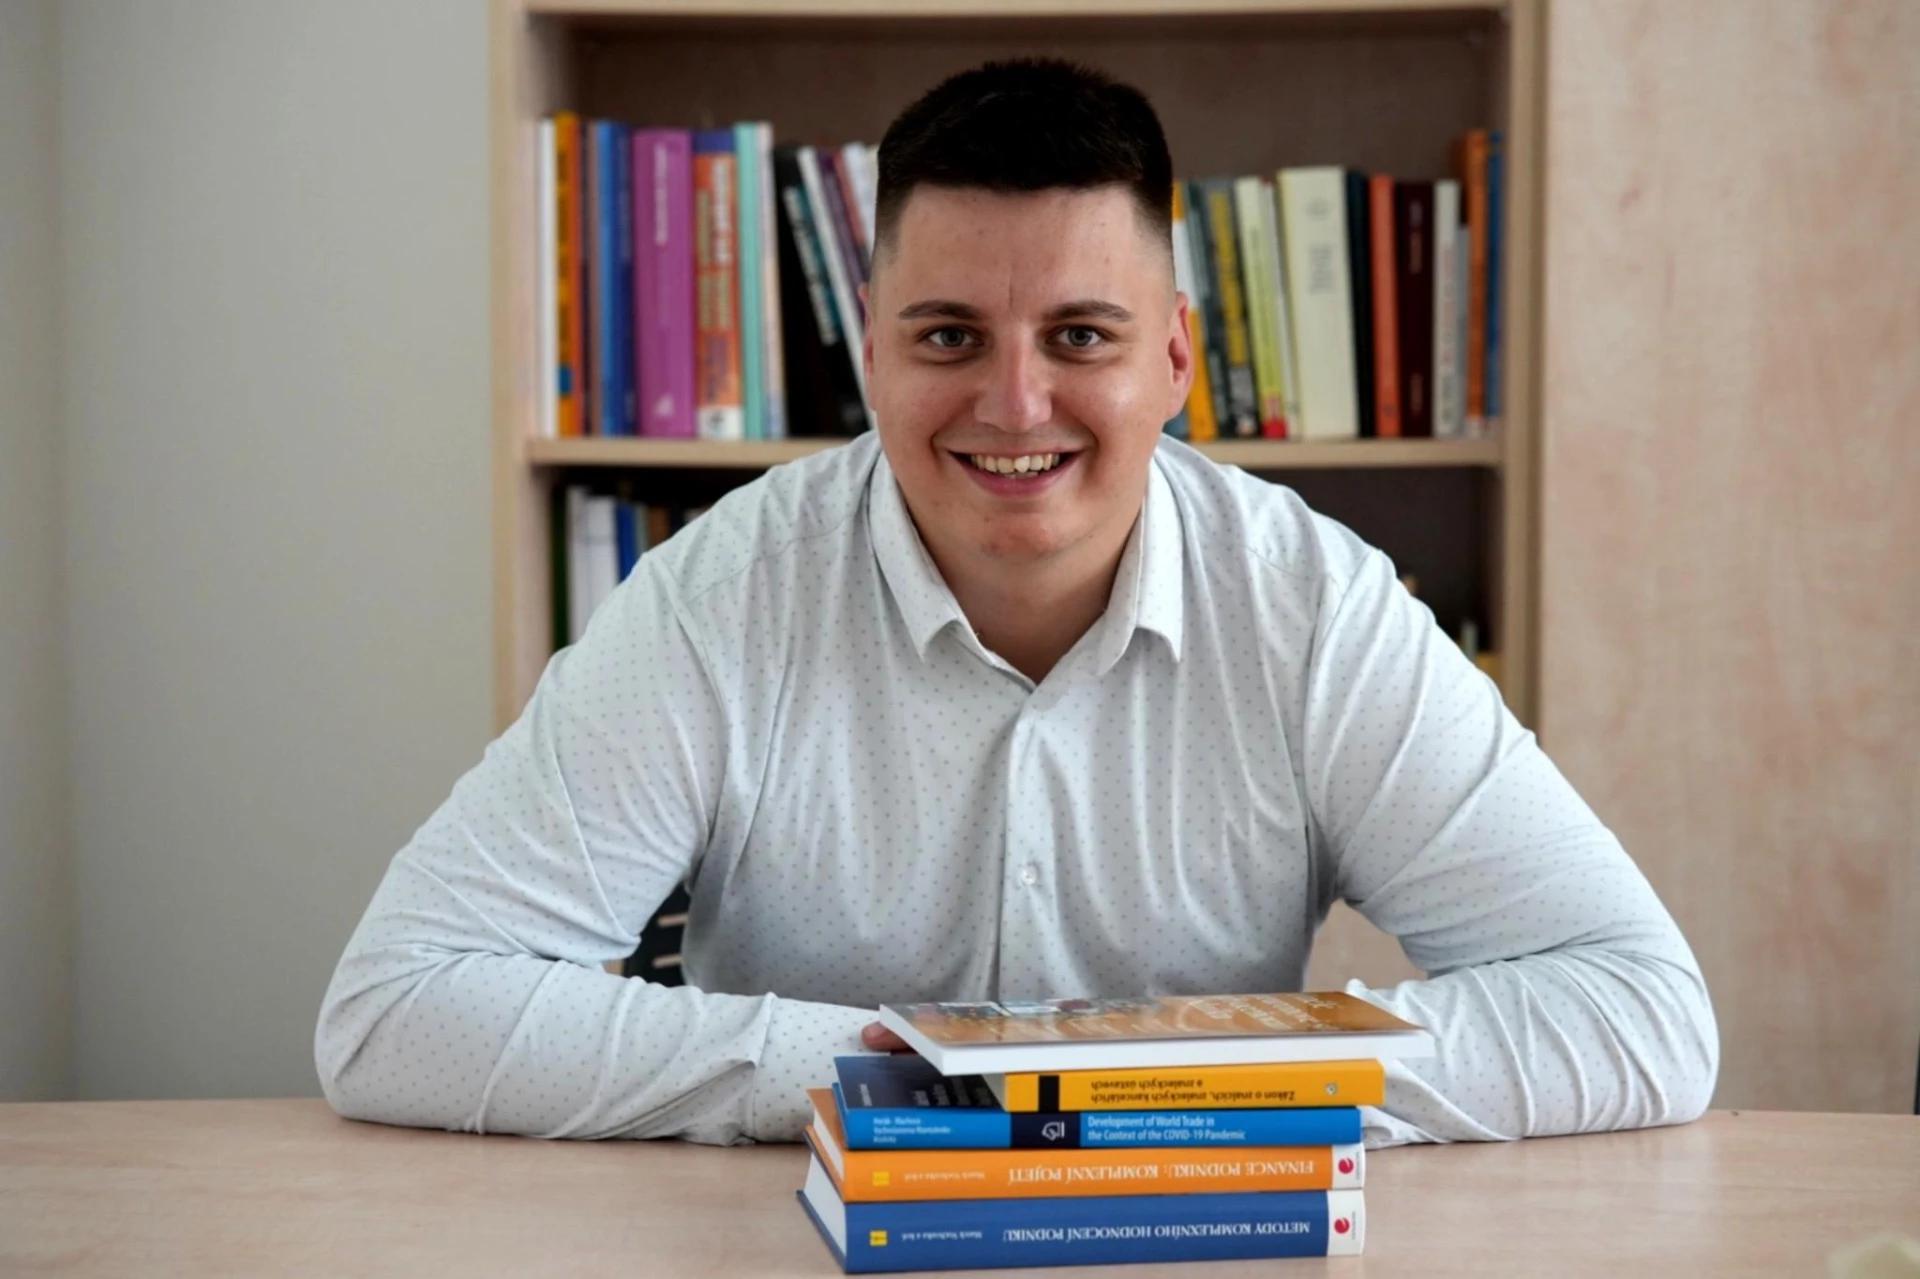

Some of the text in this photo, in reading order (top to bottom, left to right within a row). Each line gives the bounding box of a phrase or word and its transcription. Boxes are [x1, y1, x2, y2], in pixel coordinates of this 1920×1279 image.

[1140, 1078, 1194, 1089] znaleckých
[1152, 1091, 1206, 1102] znaleckých
[1087, 1116, 1215, 1128] Development of World Trade in
[1087, 1130, 1102, 1140] the
[1104, 1130, 1136, 1140] Context
[1137, 1129, 1148, 1140] of
[1148, 1129, 1161, 1140] the
[1205, 1128, 1246, 1139] Pandemic
[1008, 1166, 1062, 1184] POJETÍ
[1067, 1165, 1158, 1183] KOMPLEXNÍ
[1246, 1160, 1314, 1176] FINANCE
[1003, 1221, 1311, 1243] METODY KOMPLEXNÍHO HODNOCENÍ PODNIKU
